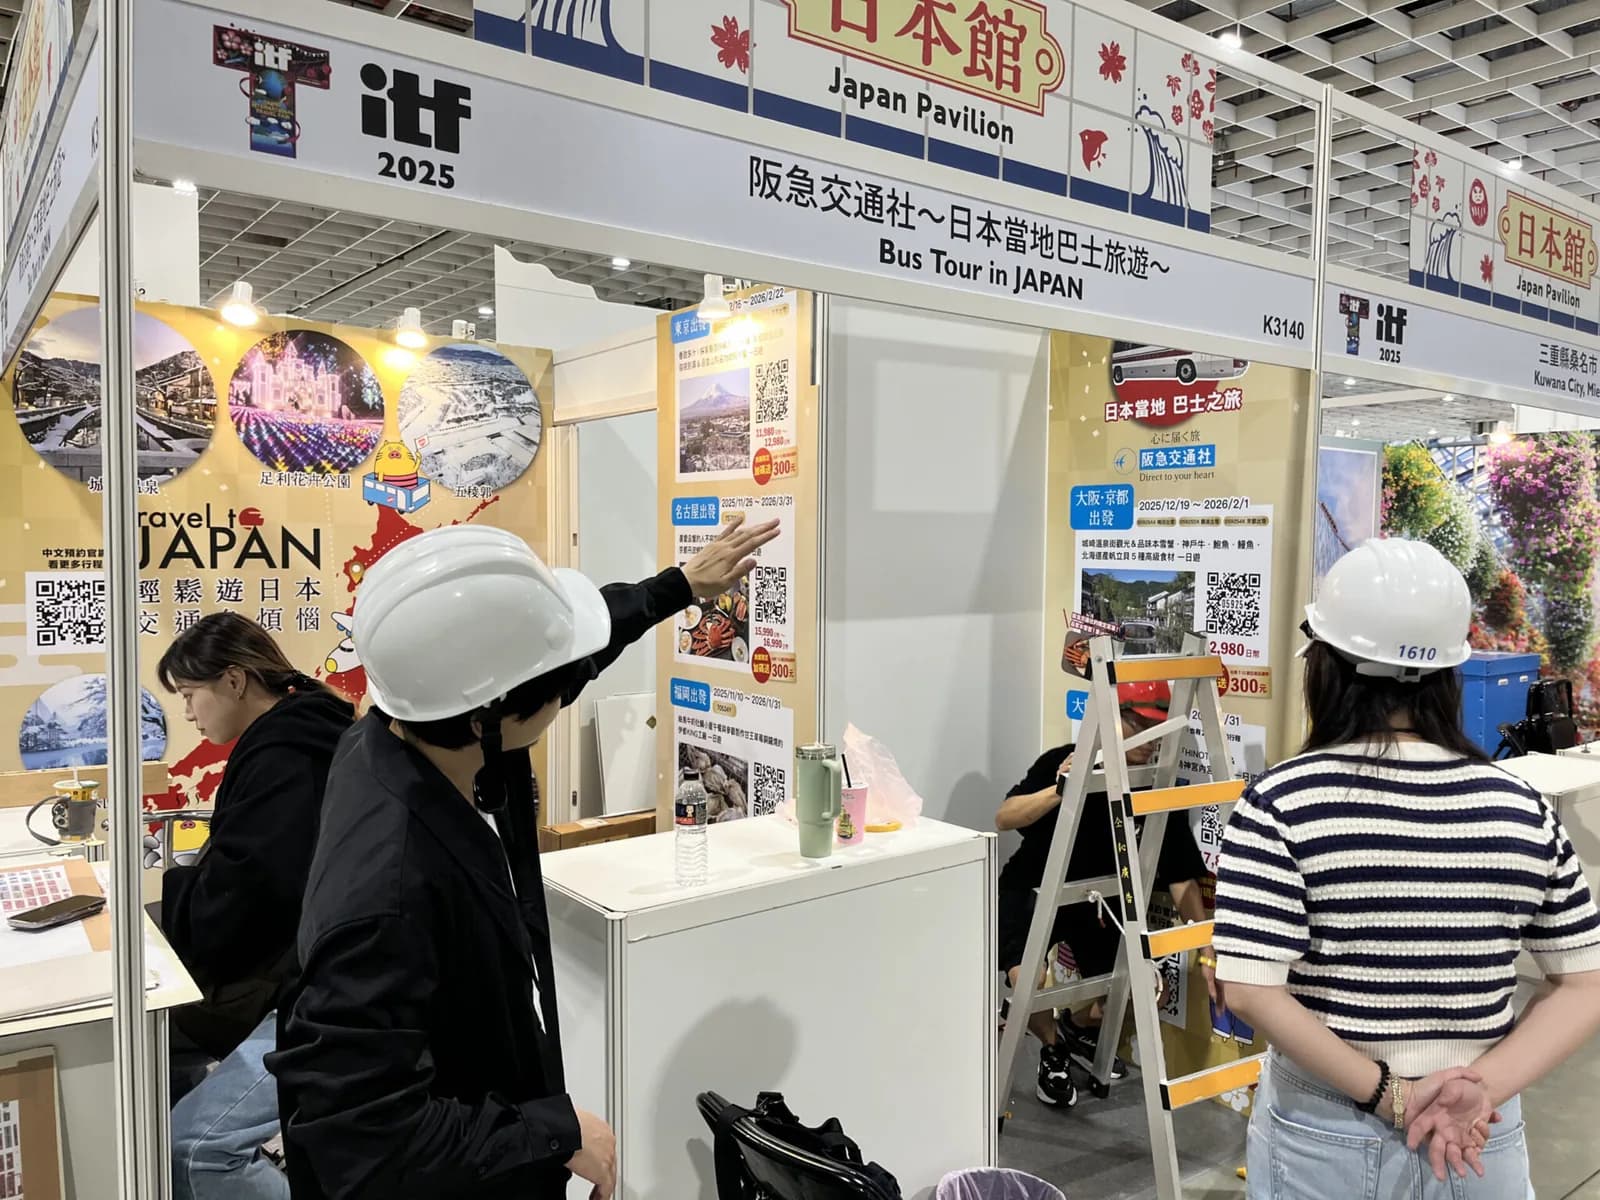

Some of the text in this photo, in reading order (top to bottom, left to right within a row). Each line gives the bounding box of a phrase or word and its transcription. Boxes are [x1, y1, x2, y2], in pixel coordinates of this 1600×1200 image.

[360, 62, 472, 154] itf
[828, 66, 1014, 145] Japan Pavilion
[377, 151, 456, 189] 2025
[1516, 211, 1586, 279] 日本館
[879, 238, 1084, 301] Bus Tour in JAPAN
[750, 288, 784, 306] 2026/2/22
[1516, 274, 1580, 309] Japan Pavilion
[1263, 314, 1305, 341] K3140
[1375, 303, 1408, 345] itf
[1379, 347, 1401, 364] 2025
[1534, 370, 1566, 392] Kuwana
[1567, 378, 1586, 398] City,
[1104, 389, 1243, 422] 日本當地 巴士之旅
[1150, 430, 1201, 445] 心に届く旅
[1141, 448, 1212, 467] 阪急交通社
[1139, 470, 1215, 483] Direct to your heart
[138, 503, 211, 528] ravel
[675, 503, 717, 519] 名古屋出發
[1089, 510, 1114, 527] 出發
[1139, 500, 1190, 511] 2025/12/19
[1204, 499, 1249, 511] 2026/2/1
[139, 525, 322, 570] JAPAN
[139, 607, 321, 636] 交通煩惱
[1399, 644, 1437, 661] 1610
[1231, 677, 1267, 694] 300元
